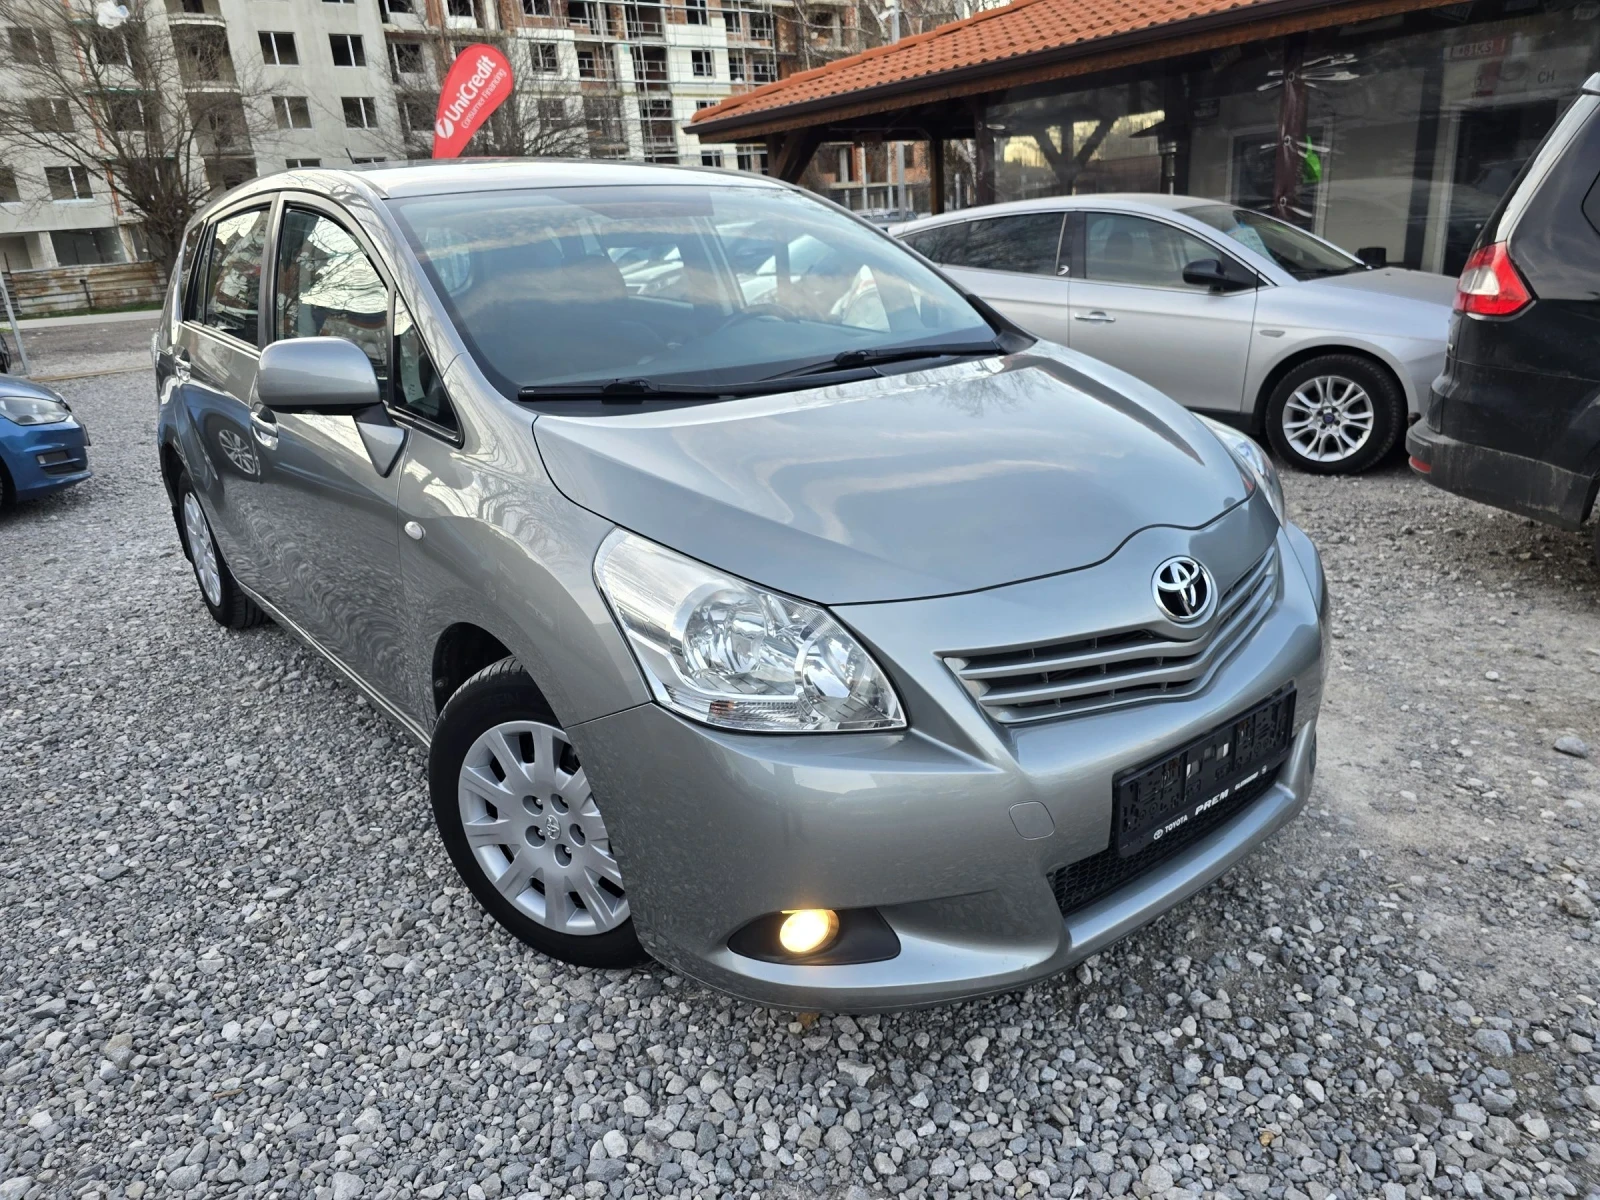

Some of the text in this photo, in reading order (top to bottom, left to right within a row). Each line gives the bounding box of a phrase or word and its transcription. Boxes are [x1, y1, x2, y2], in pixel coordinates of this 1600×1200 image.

[444, 54, 497, 122] UniCredit
[461, 68, 508, 129] Consumer Financing
[1164, 788, 1229, 833] TOYOTA PREM
